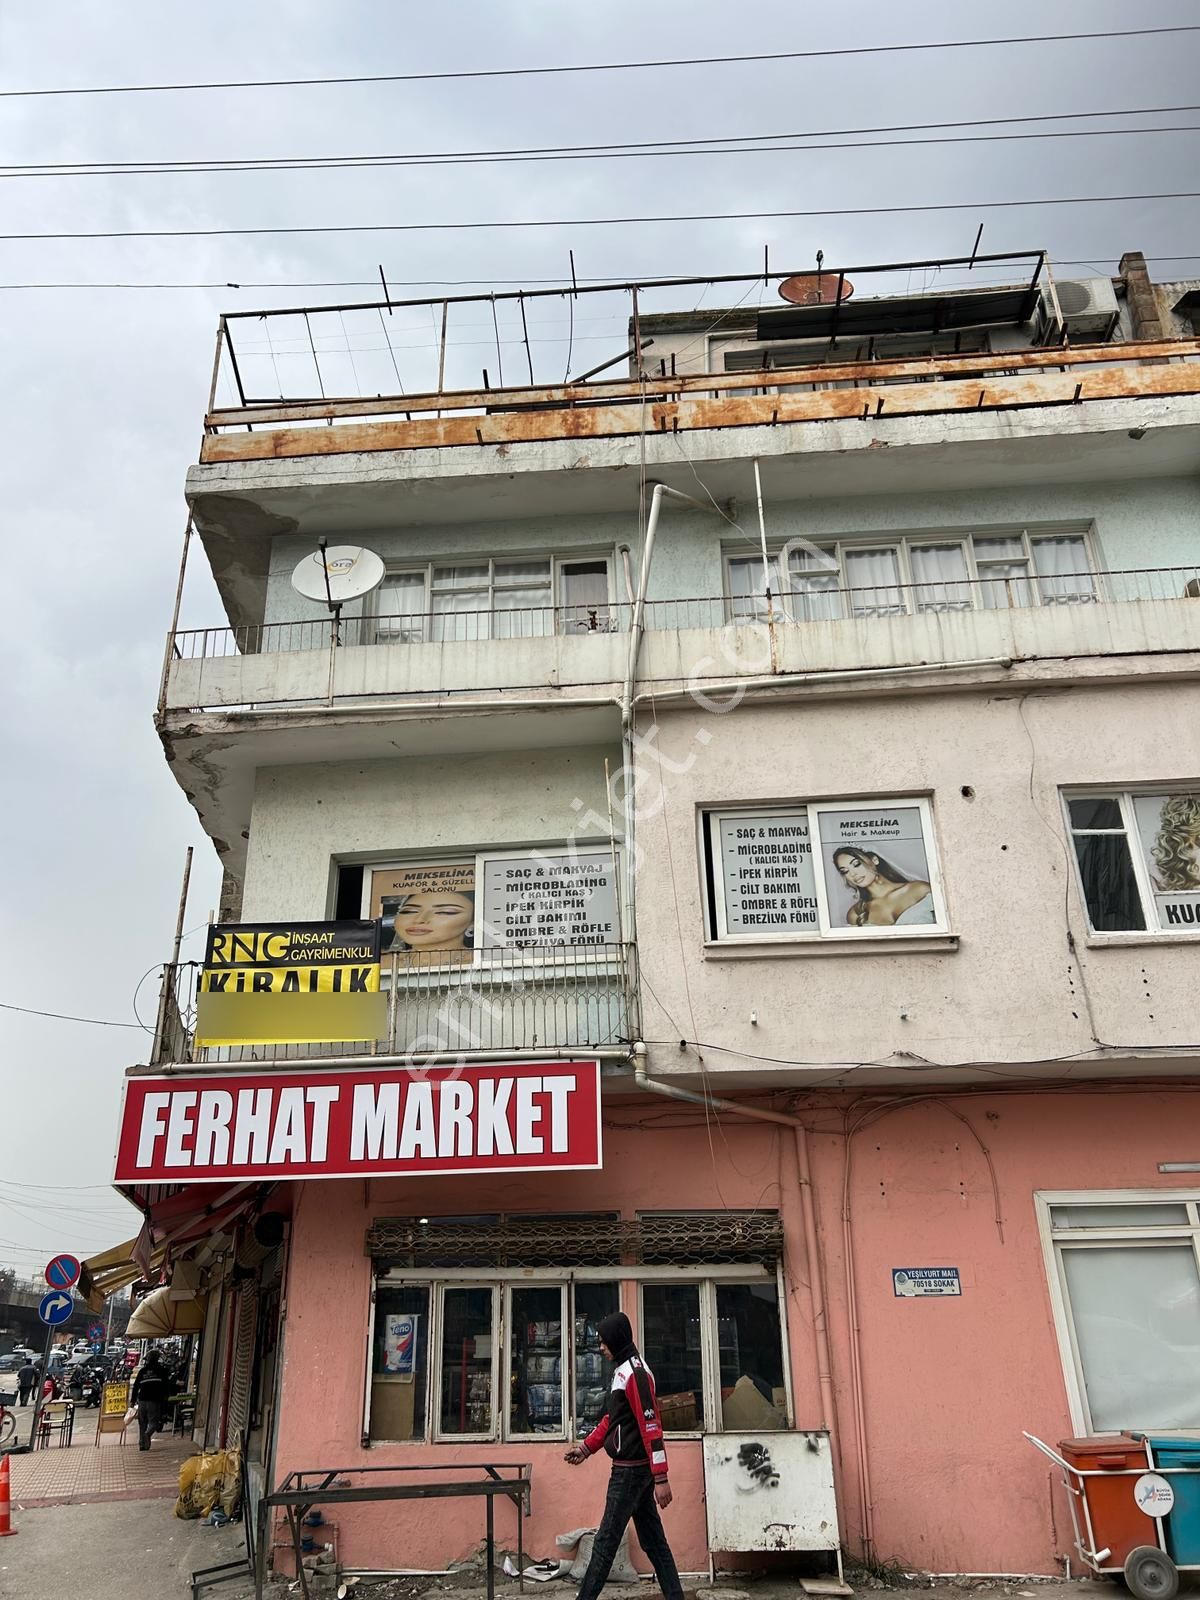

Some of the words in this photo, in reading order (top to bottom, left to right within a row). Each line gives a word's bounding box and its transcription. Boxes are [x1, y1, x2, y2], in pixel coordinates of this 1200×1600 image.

[840, 818, 899, 829] MEKSELİNA
[736, 828, 756, 840] SAÇ
[758, 828, 765, 838] &
[768, 826, 808, 837] MAKYAJ
[738, 842, 812, 855] MİCROBLADİNG
[755, 855, 779, 864] KALICI
[782, 855, 798, 864] KAŞ
[404, 868, 474, 880] MEKSELİNA
[506, 868, 532, 879] SAÇ
[536, 868, 544, 877] &
[549, 864, 603, 876] MAKYAJ
[739, 866, 761, 879] İPEK
[764, 865, 798, 879] KİRPİK
[392, 880, 428, 888] KUAFÖR
[506, 878, 607, 892] MİCROBLADİNG
[740, 883, 760, 895] CİLT
[763, 883, 801, 894] BAKIMI
[528, 891, 561, 899] KALICI
[565, 889, 586, 898] KAŞ
[506, 901, 535, 912] İPEK
[540, 899, 585, 910] KİRPİK
[741, 899, 777, 910] OMBRE
[780, 898, 787, 909] &
[505, 915, 532, 925] CİLT
[537, 912, 587, 923] BAKIMI
[742, 911, 787, 925] BREZİLYA
[790, 910, 816, 923] FÖNÜ
[505, 926, 554, 938] OMBRE
[558, 925, 567, 934] &
[571, 923, 612, 934] RÖFLE
[292, 931, 335, 946] İNŞAAT
[211, 932, 291, 963] RNG
[291, 946, 373, 961] GAYRİMENKUL
[135, 1084, 340, 1169] FERHAT
[348, 1075, 577, 1161] MARKET
[907, 1271, 940, 1279] YEŞİLYURT
[391, 1325, 410, 1334] Teno
